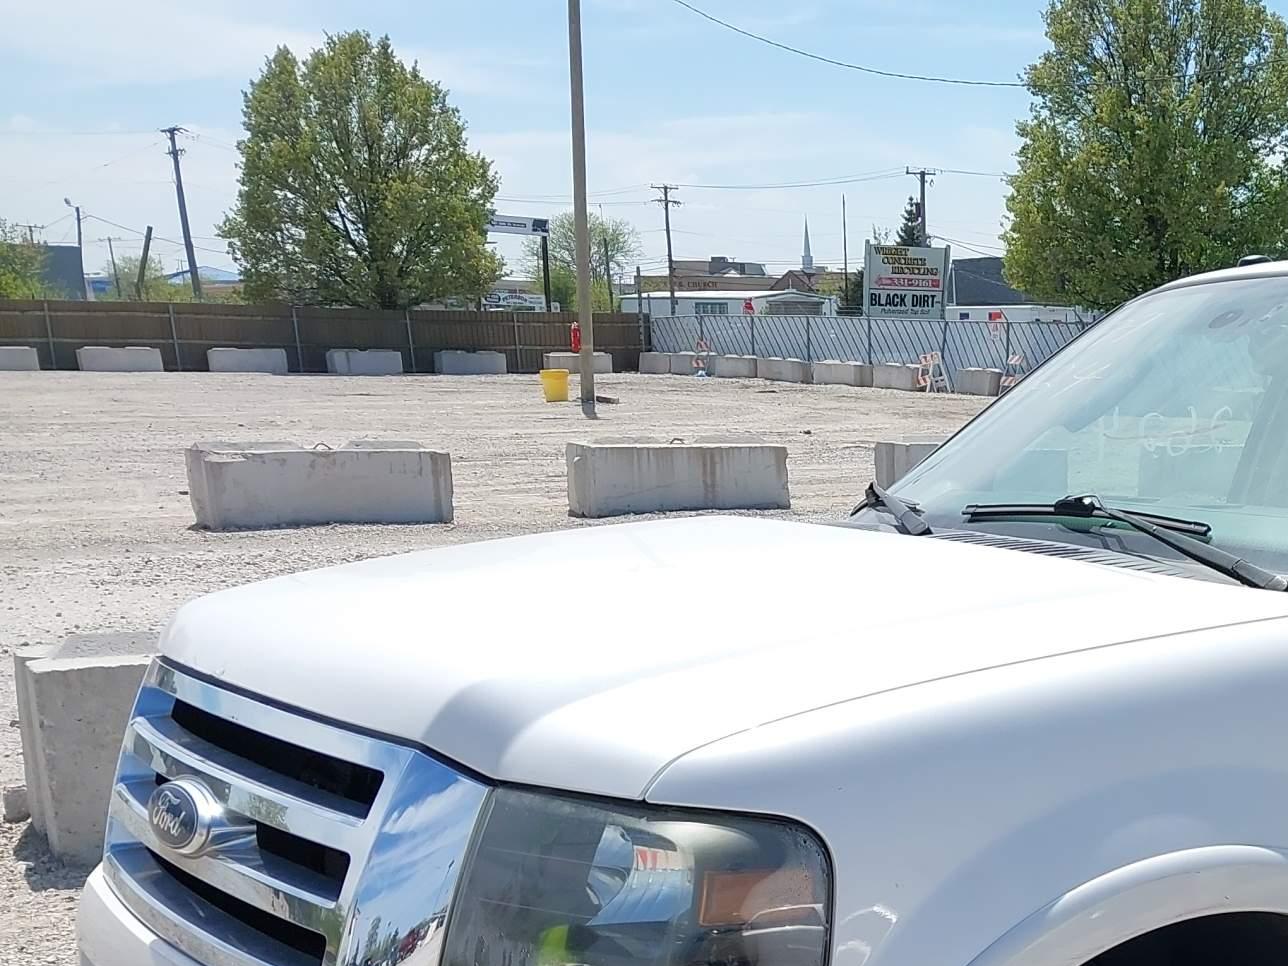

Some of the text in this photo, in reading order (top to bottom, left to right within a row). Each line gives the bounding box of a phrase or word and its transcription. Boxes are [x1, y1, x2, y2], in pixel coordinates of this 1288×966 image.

[870, 293, 936, 308] BLACK DIRT
[152, 791, 186, 837] Ford
